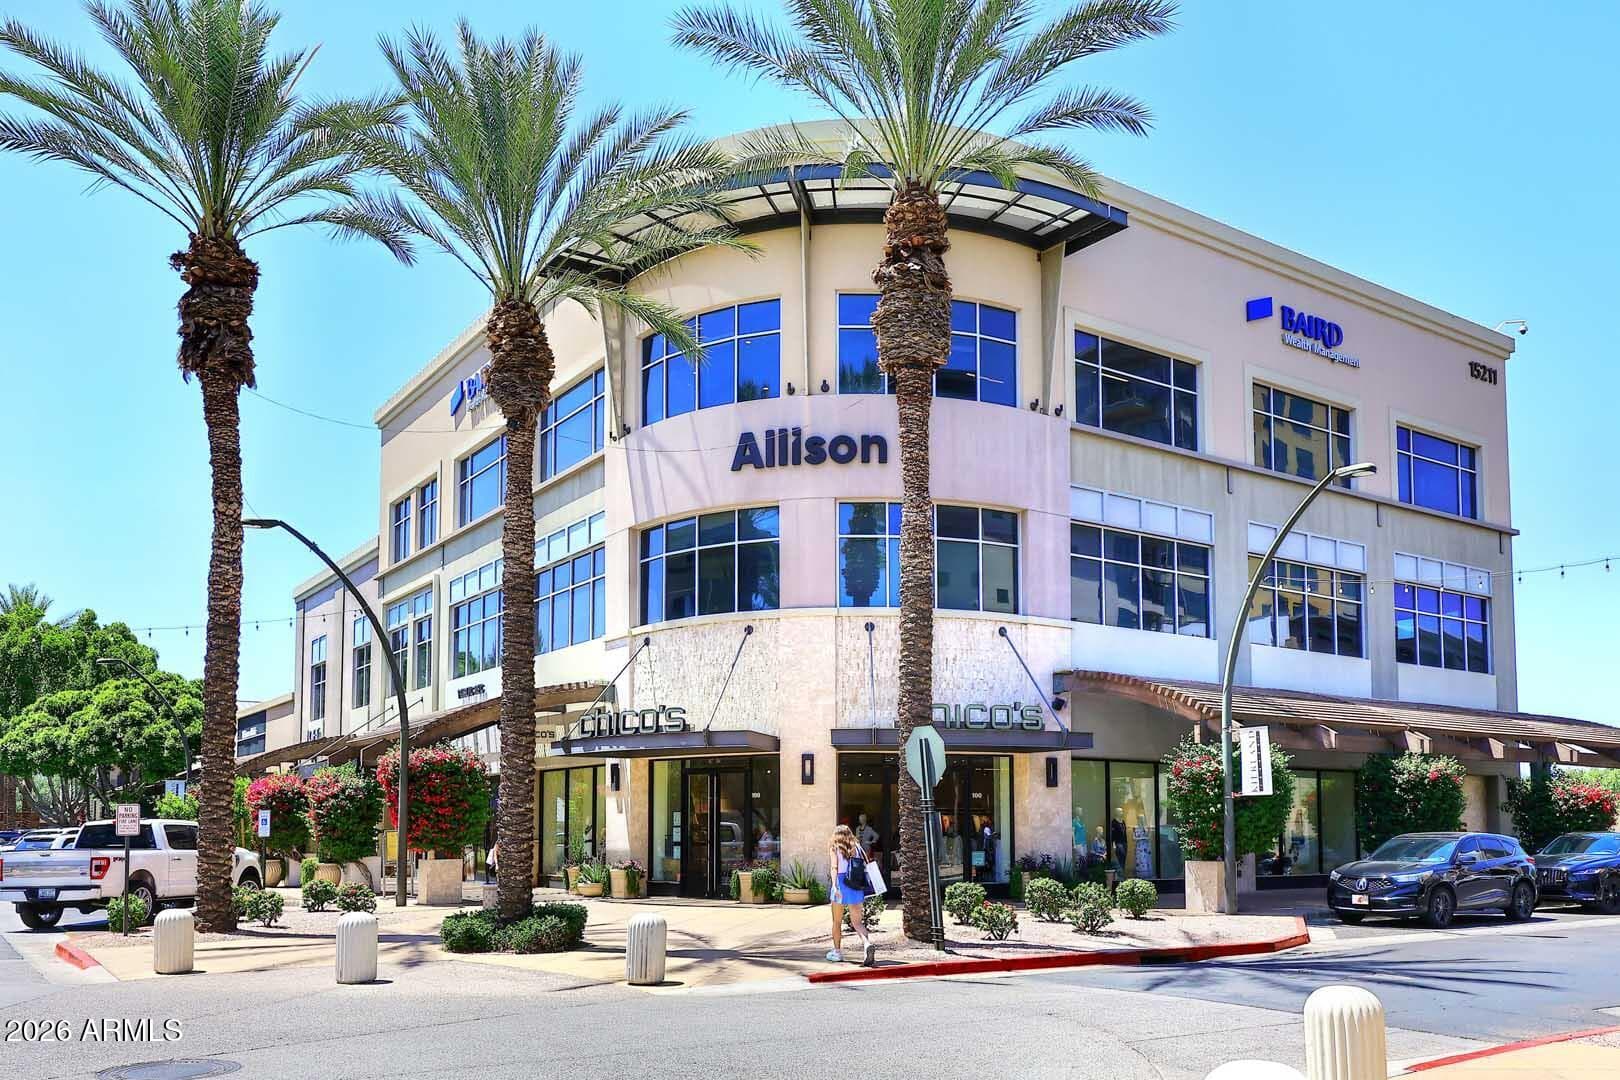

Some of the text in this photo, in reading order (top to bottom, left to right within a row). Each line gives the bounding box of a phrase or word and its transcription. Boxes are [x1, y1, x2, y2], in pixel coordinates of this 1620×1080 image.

[1281, 305, 1343, 348] BAIRD
[1283, 333, 1313, 353] Wealth
[1469, 361, 1497, 385] 15211
[731, 426, 888, 471] Allison
